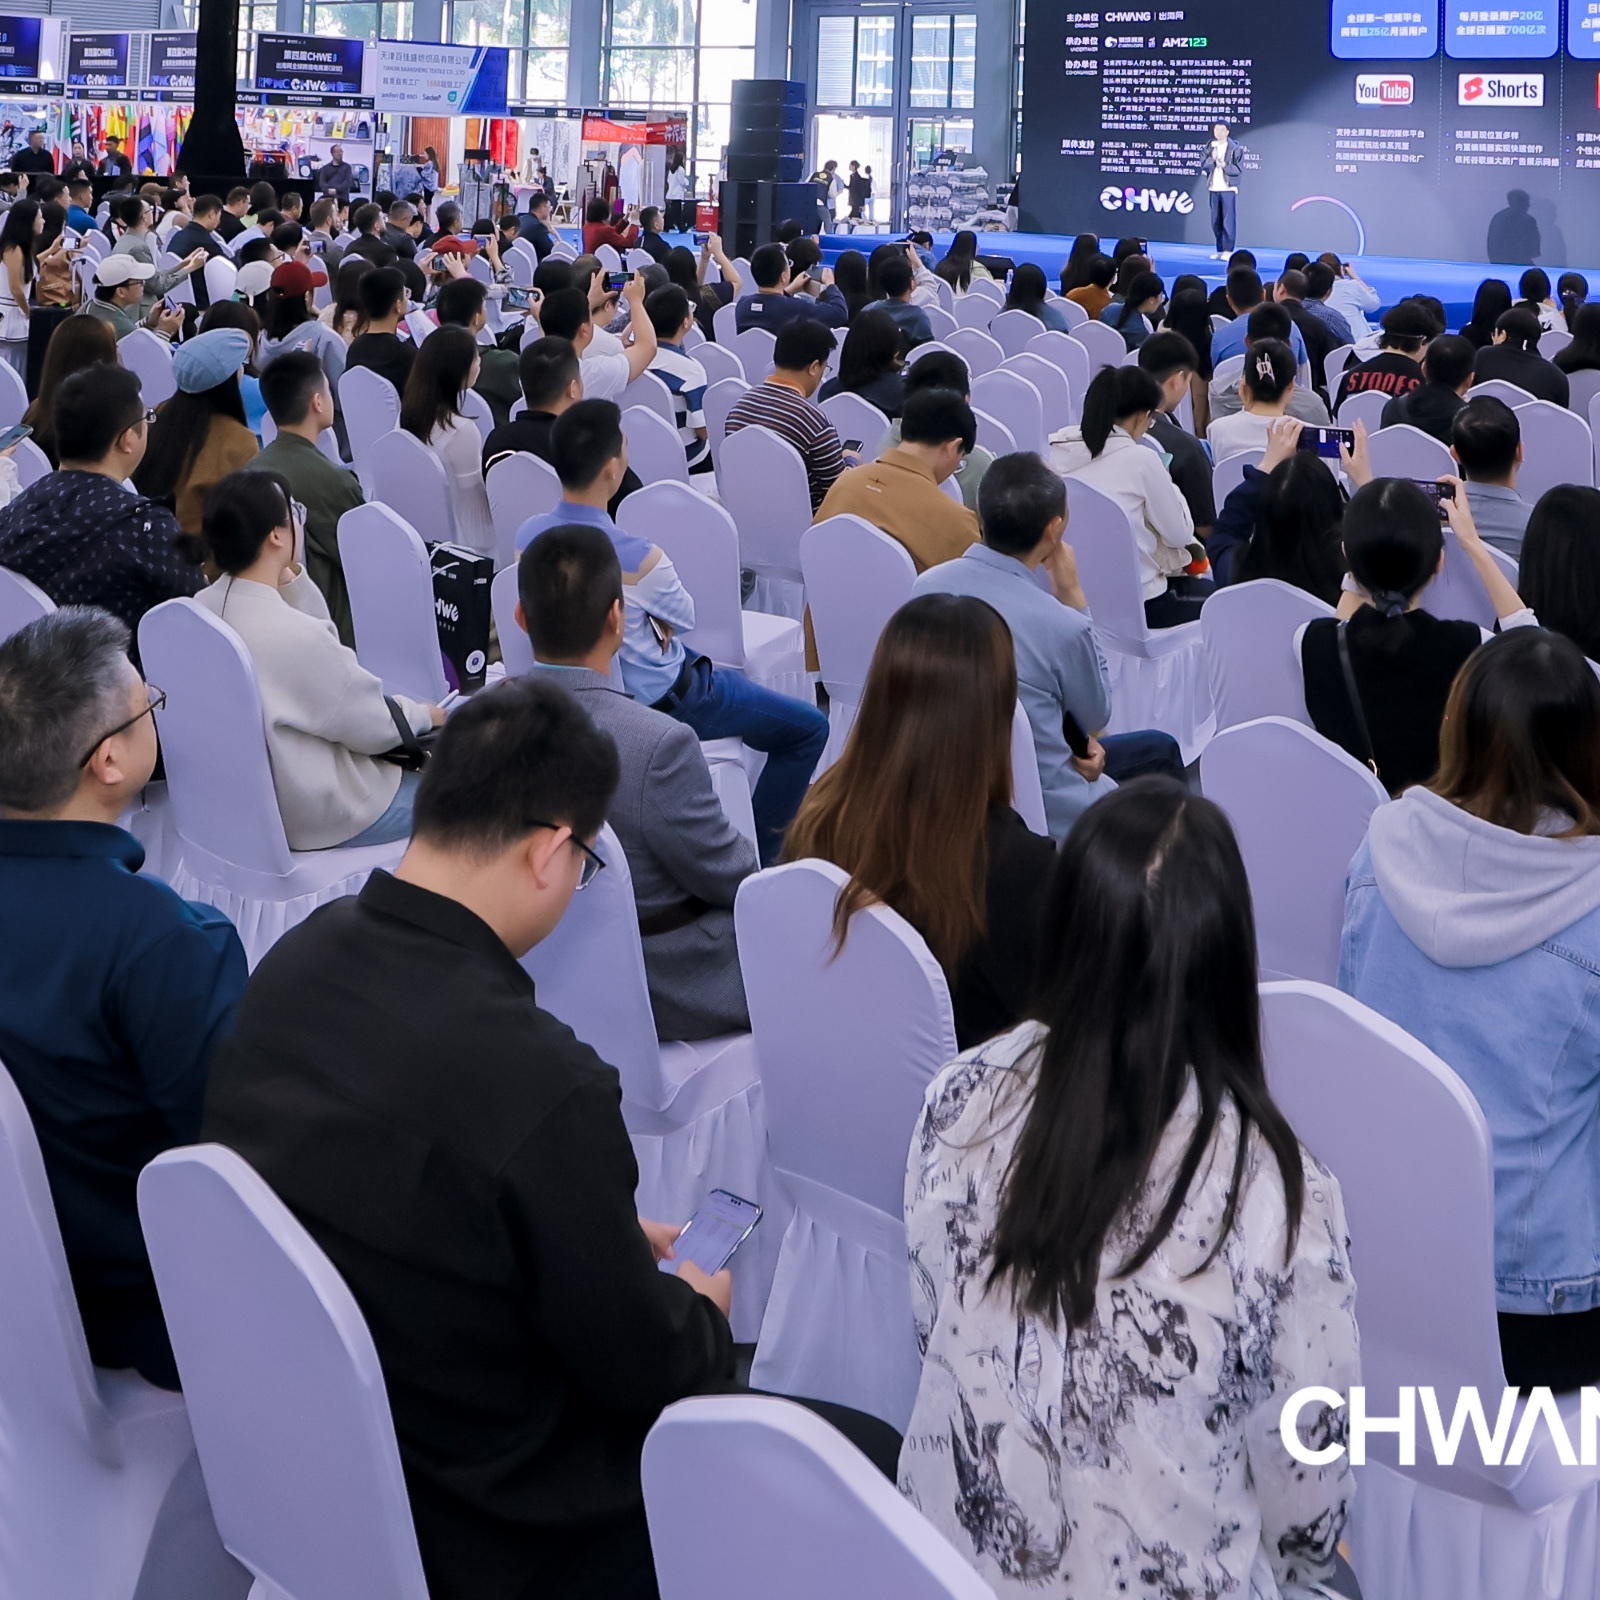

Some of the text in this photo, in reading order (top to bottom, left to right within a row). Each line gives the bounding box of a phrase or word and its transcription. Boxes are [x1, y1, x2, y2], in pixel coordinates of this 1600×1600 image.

[1105, 12, 1150, 22] CHWANG
[1162, 37, 1208, 48] AMZ123
[20, 84, 38, 93] 1C31
[1358, 82, 1409, 99] YouTube
[1487, 79, 1538, 99] Shorts
[1100, 186, 1194, 214] CHWE
